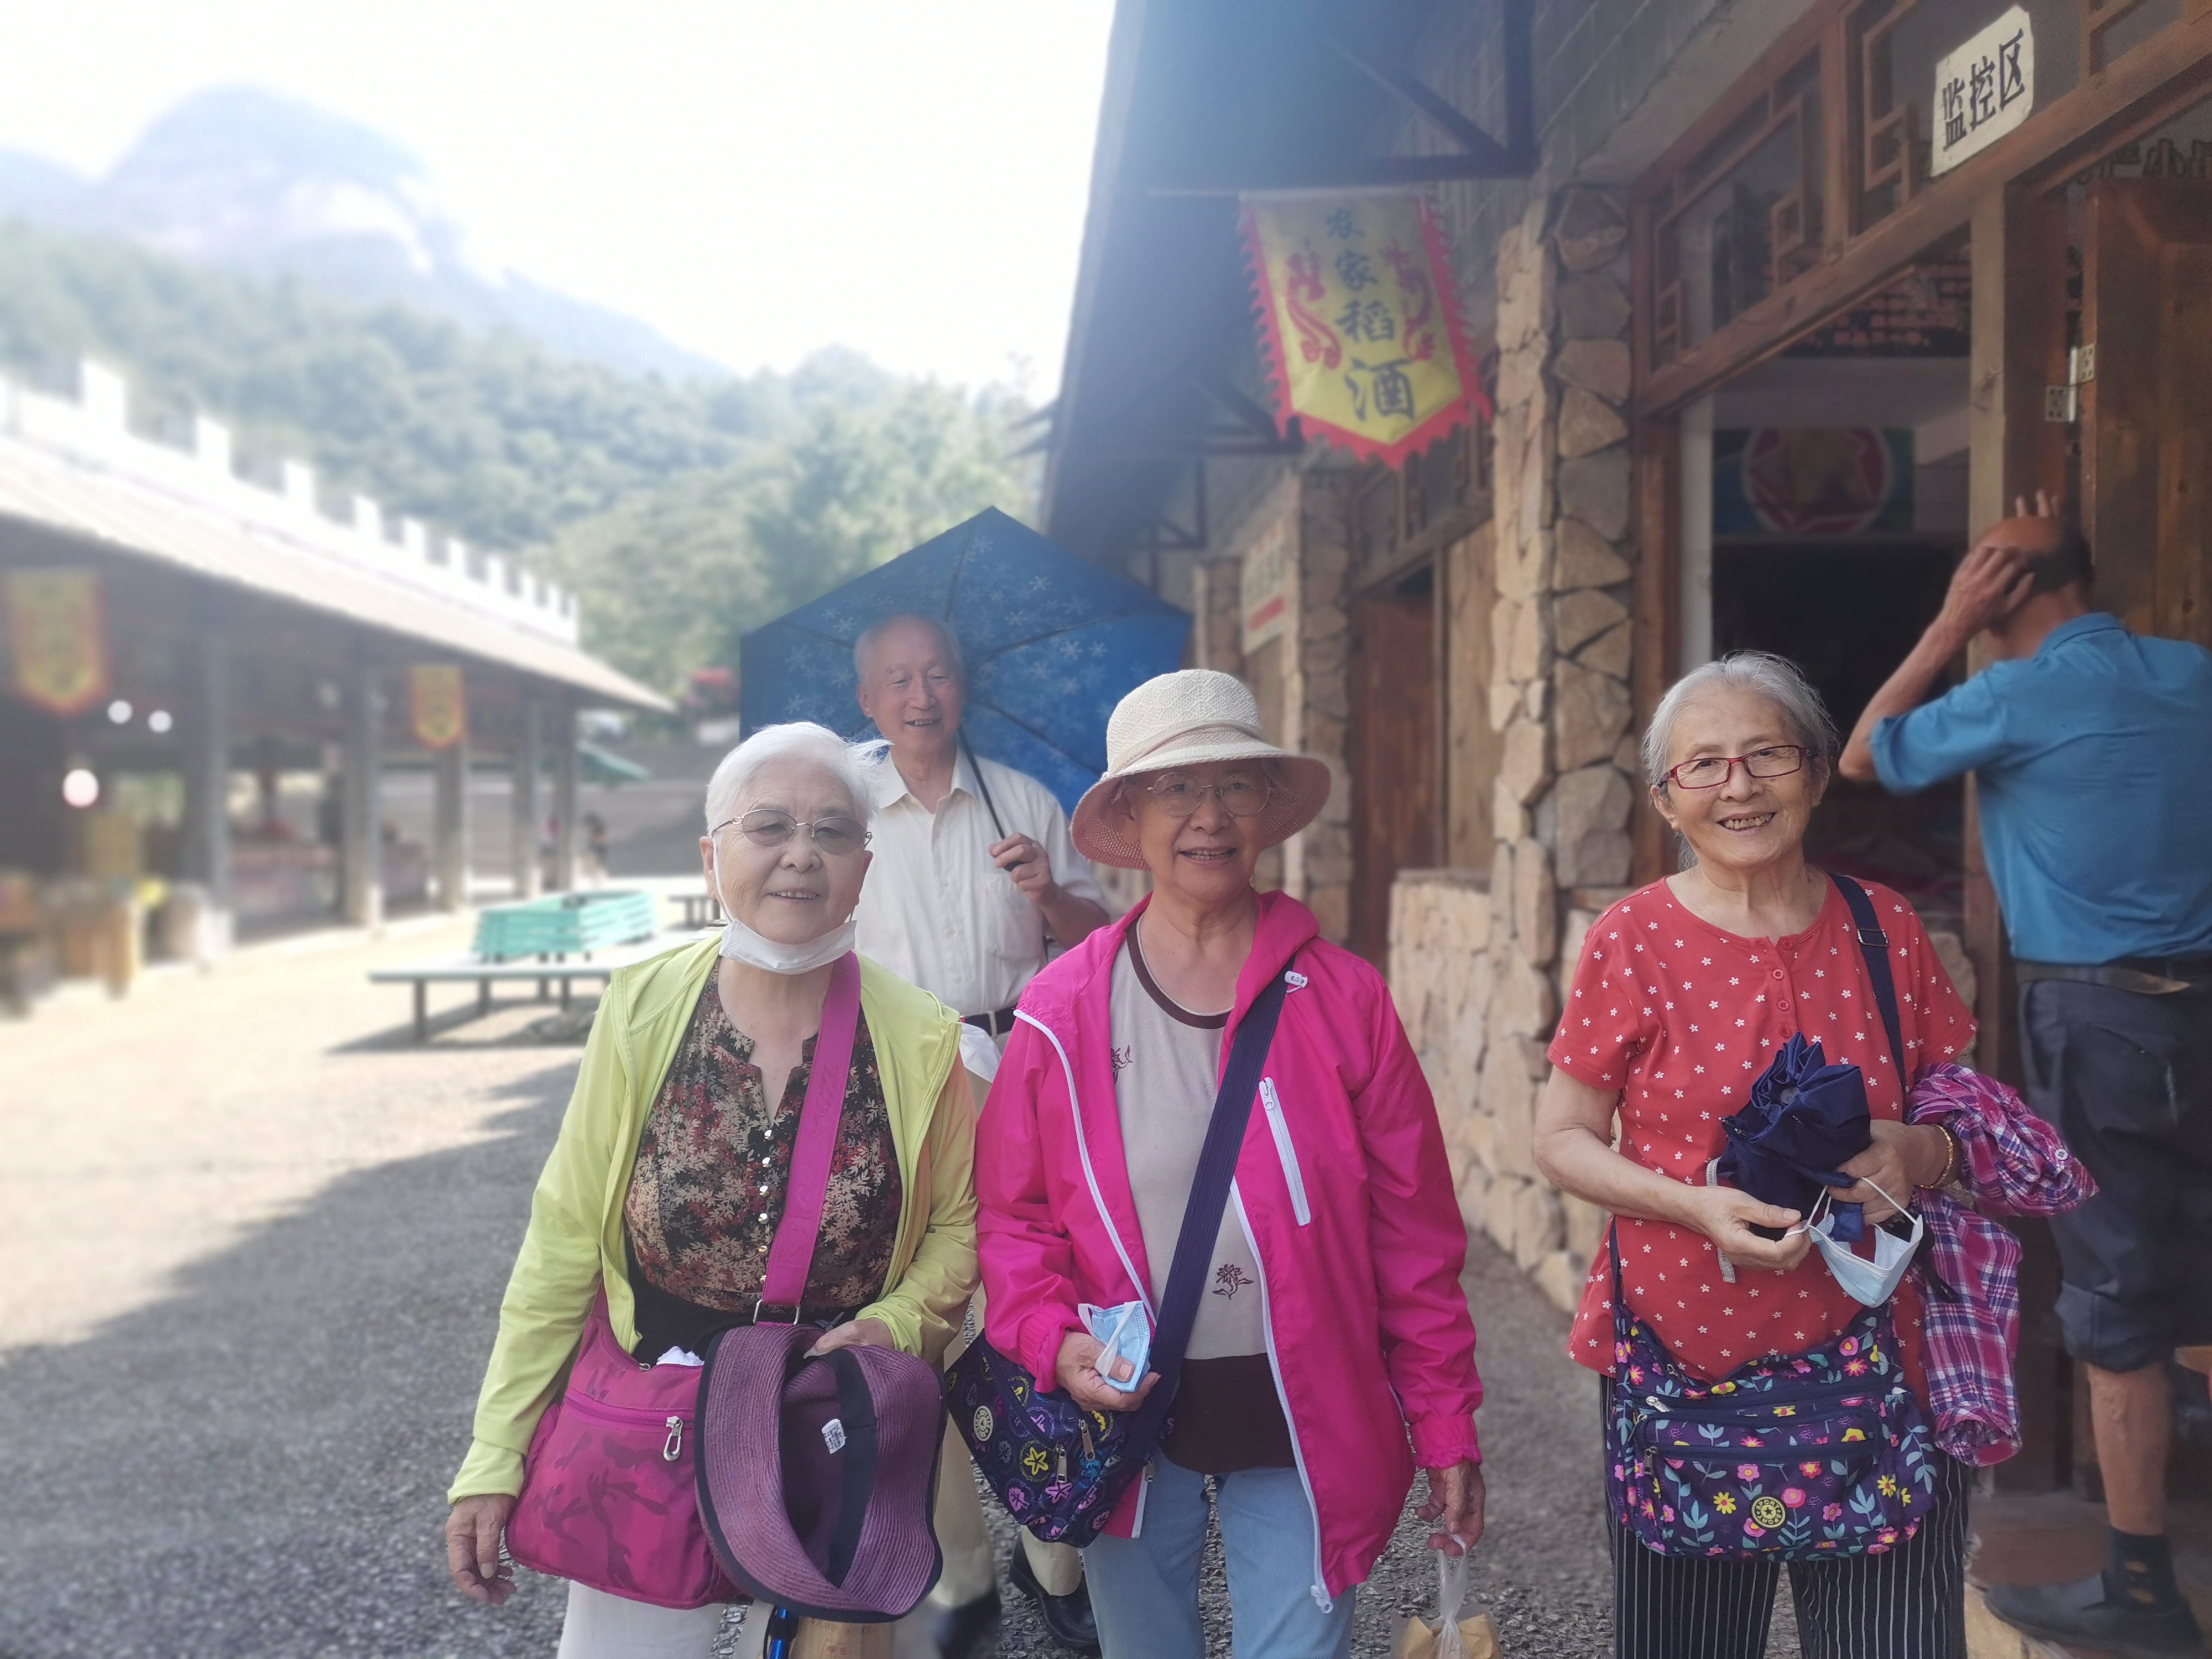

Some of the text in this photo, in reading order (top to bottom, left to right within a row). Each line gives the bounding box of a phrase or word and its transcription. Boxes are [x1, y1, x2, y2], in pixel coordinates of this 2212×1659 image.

[1942, 28, 2025, 152] 监控区
[1756, 1499, 1780, 1510] SPORT
[1757, 1514, 1781, 1525] SPORT
